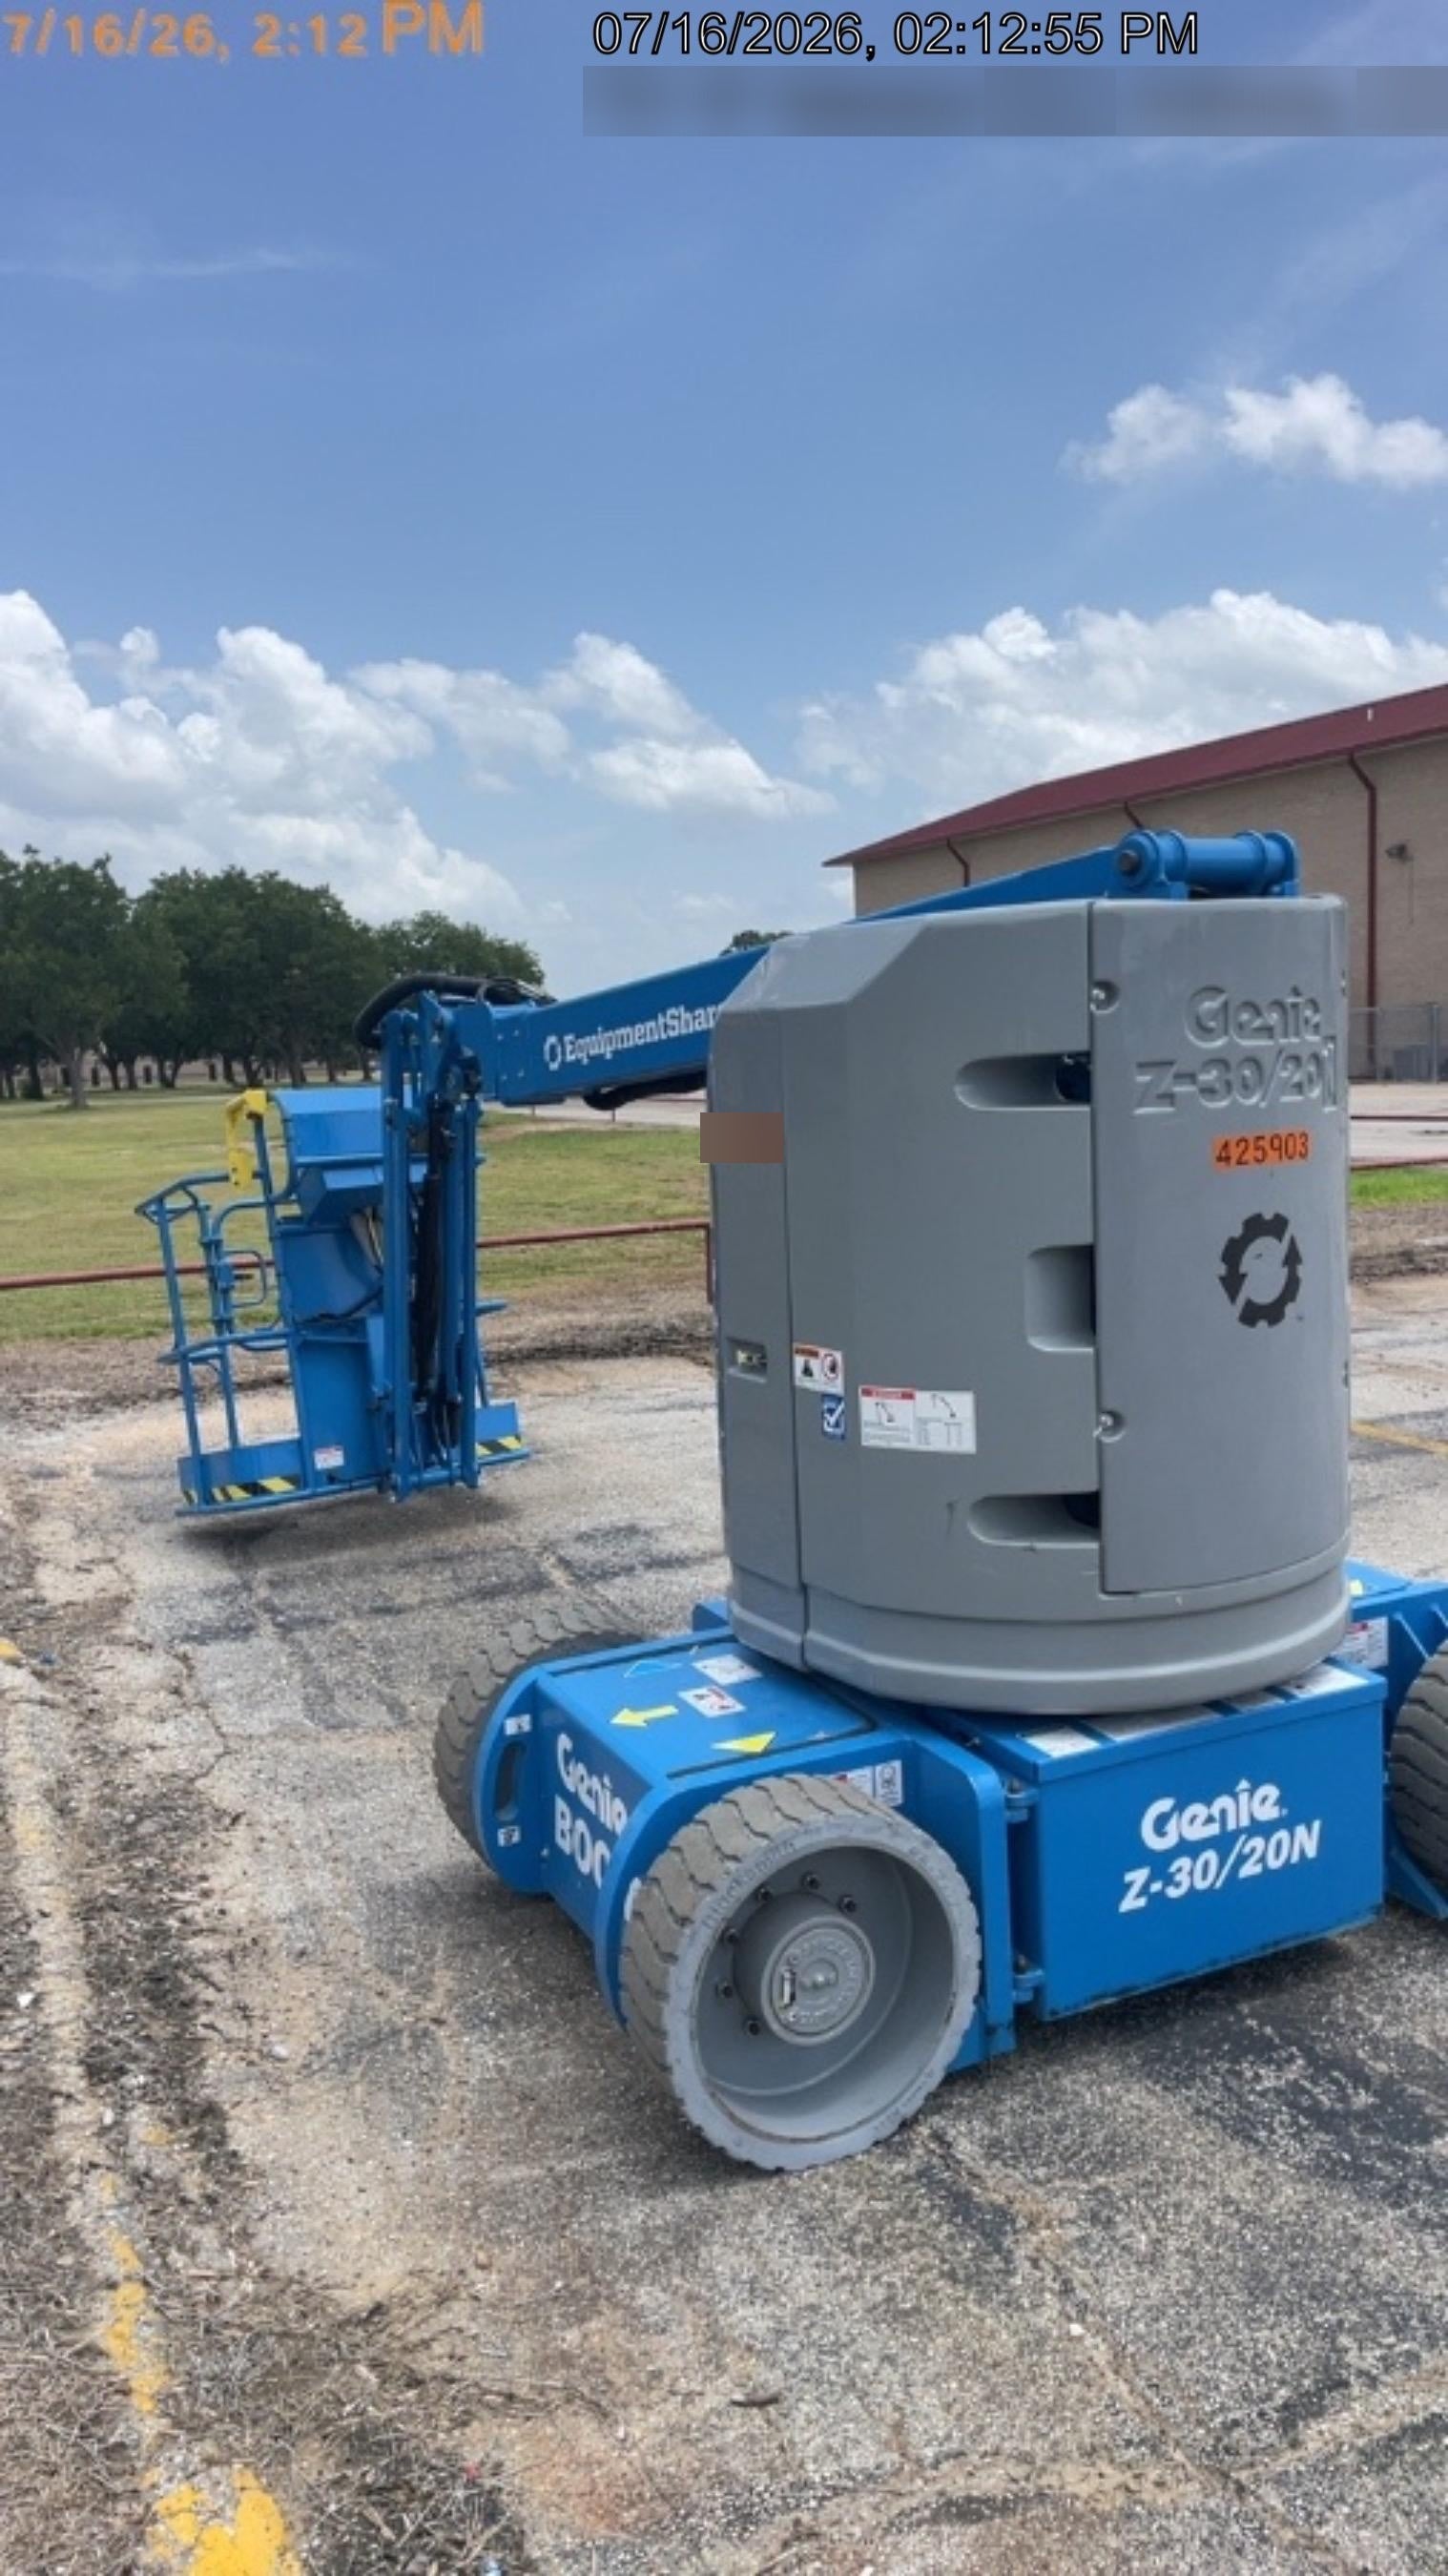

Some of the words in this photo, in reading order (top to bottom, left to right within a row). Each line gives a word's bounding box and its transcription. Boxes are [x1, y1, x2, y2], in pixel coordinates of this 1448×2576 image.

[564, 1005, 720, 1066] EquipmentShar
[1184, 985, 1322, 1048] Genie
[1215, 1132, 1310, 1166] 425903
[557, 1733, 629, 1837] Genie
[1141, 1779, 1280, 1851] Genie
[1119, 1820, 1321, 1912] Z-30/20N
